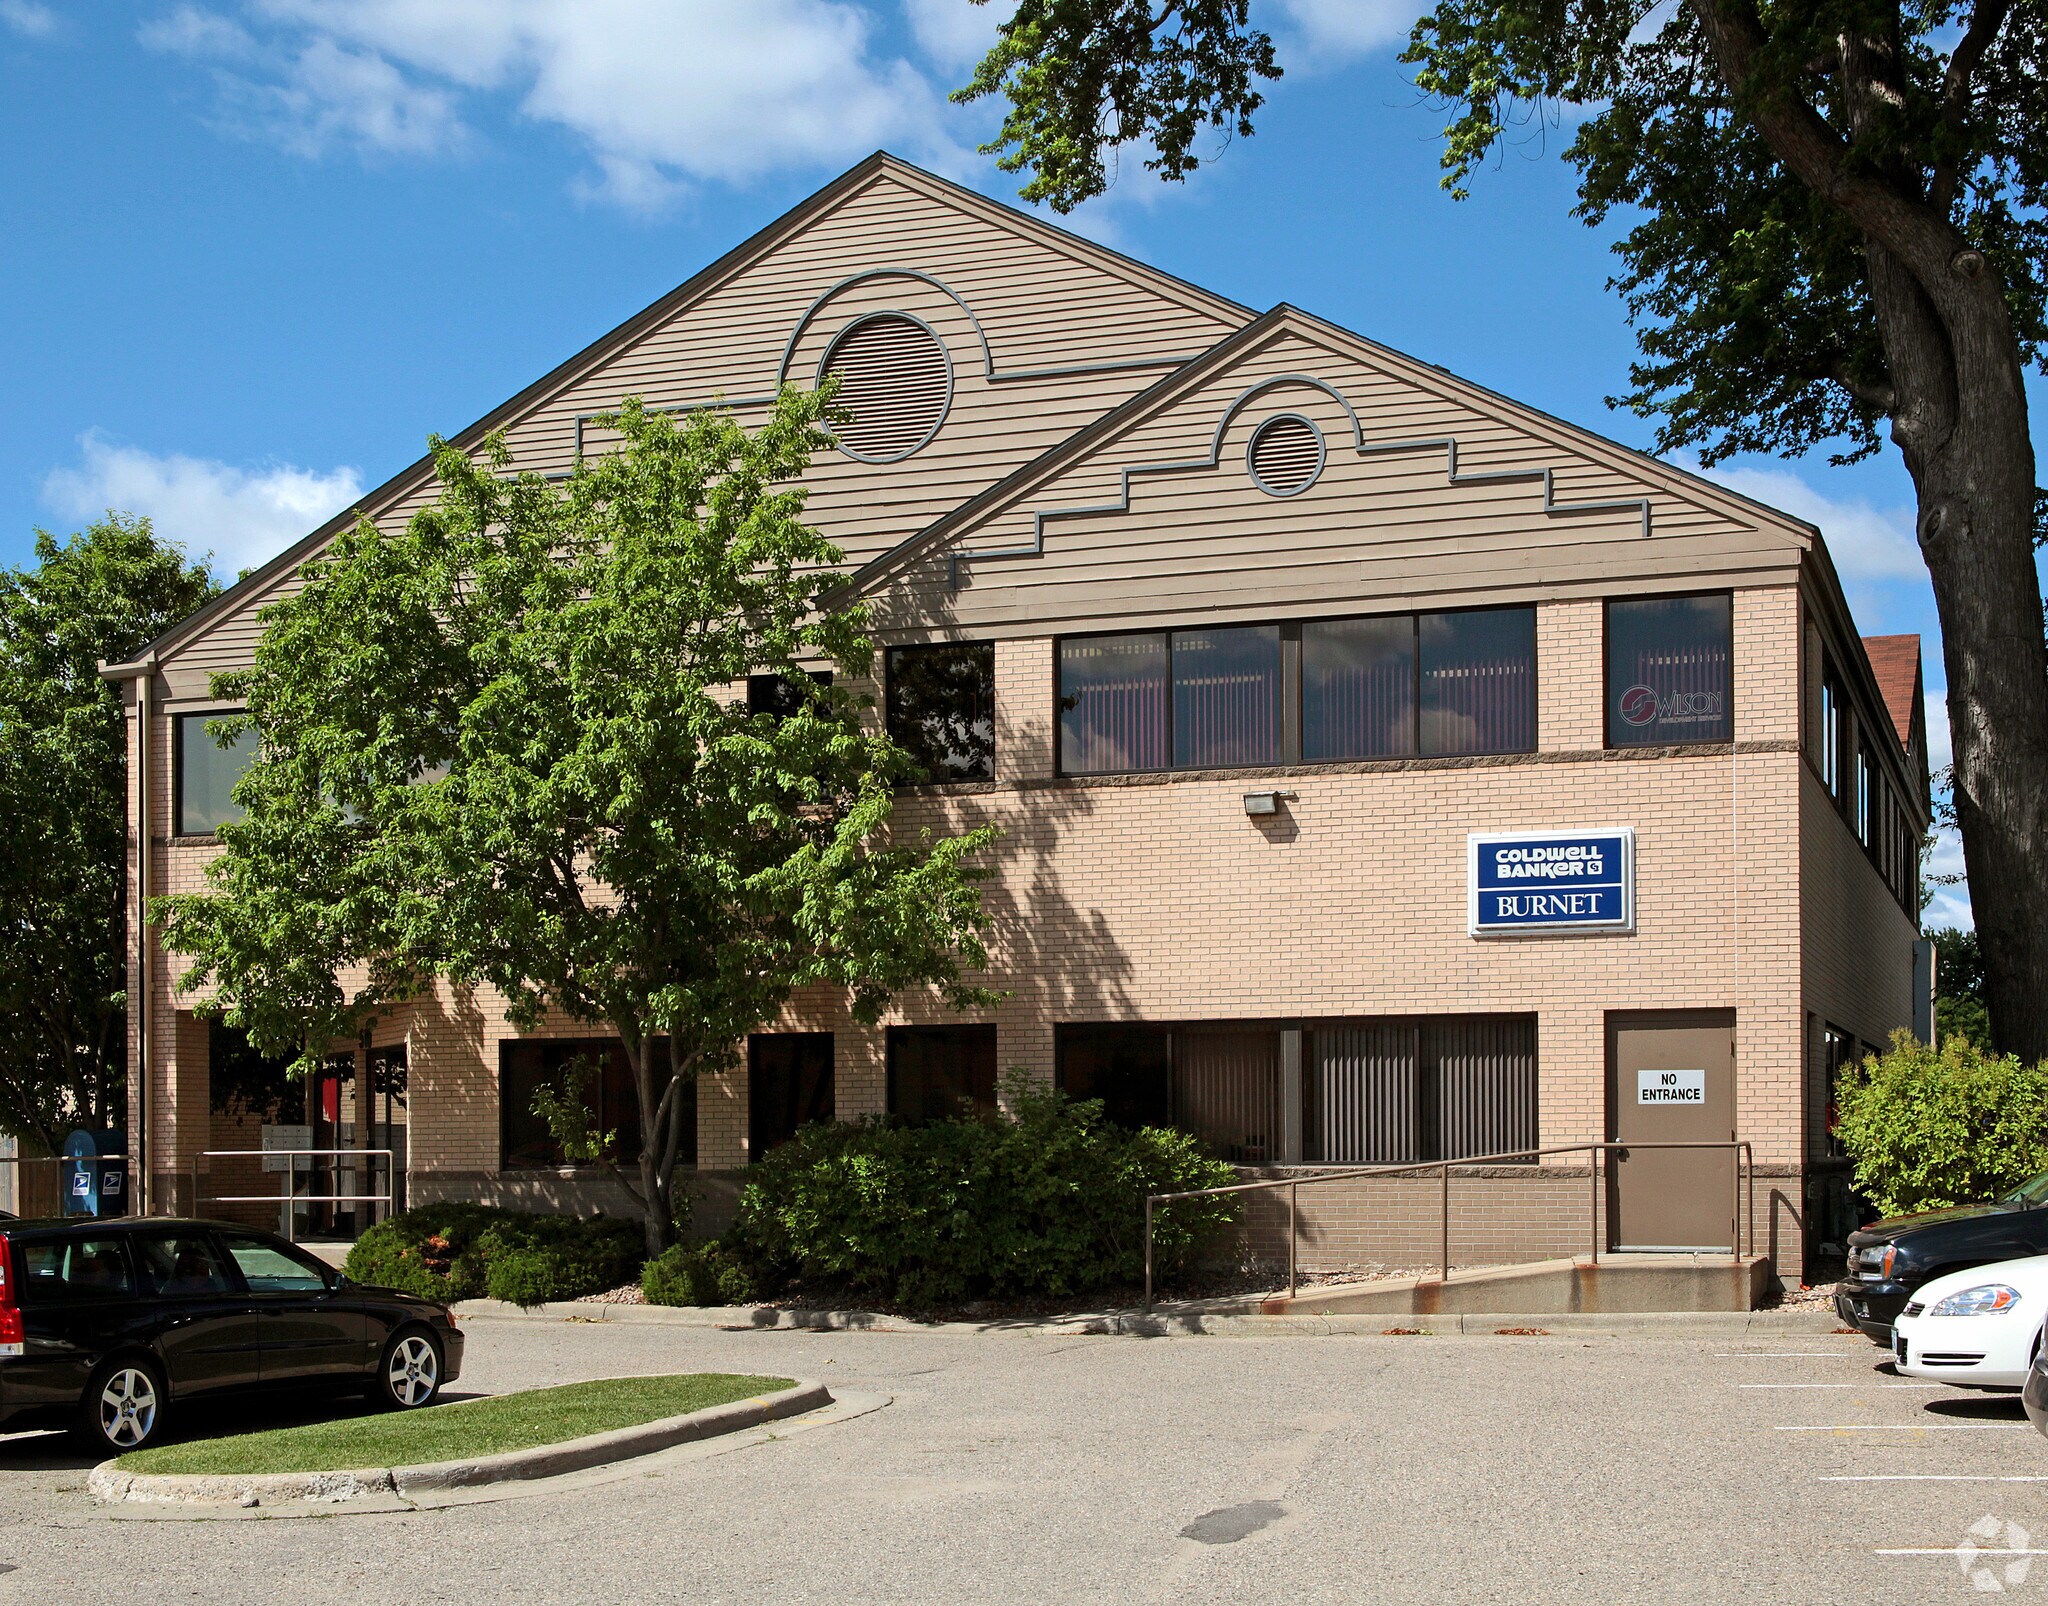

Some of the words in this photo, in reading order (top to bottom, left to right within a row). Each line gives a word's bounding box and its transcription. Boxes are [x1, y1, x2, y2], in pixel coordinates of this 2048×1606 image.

[1656, 690, 1722, 717] WILSON
[1495, 845, 1603, 863] COLDWELL
[1497, 861, 1584, 879] BANKER
[1496, 892, 1603, 917] BURNET
[1661, 1073, 1677, 1085] NO
[1642, 1088, 1700, 1101] ENTRANCE
